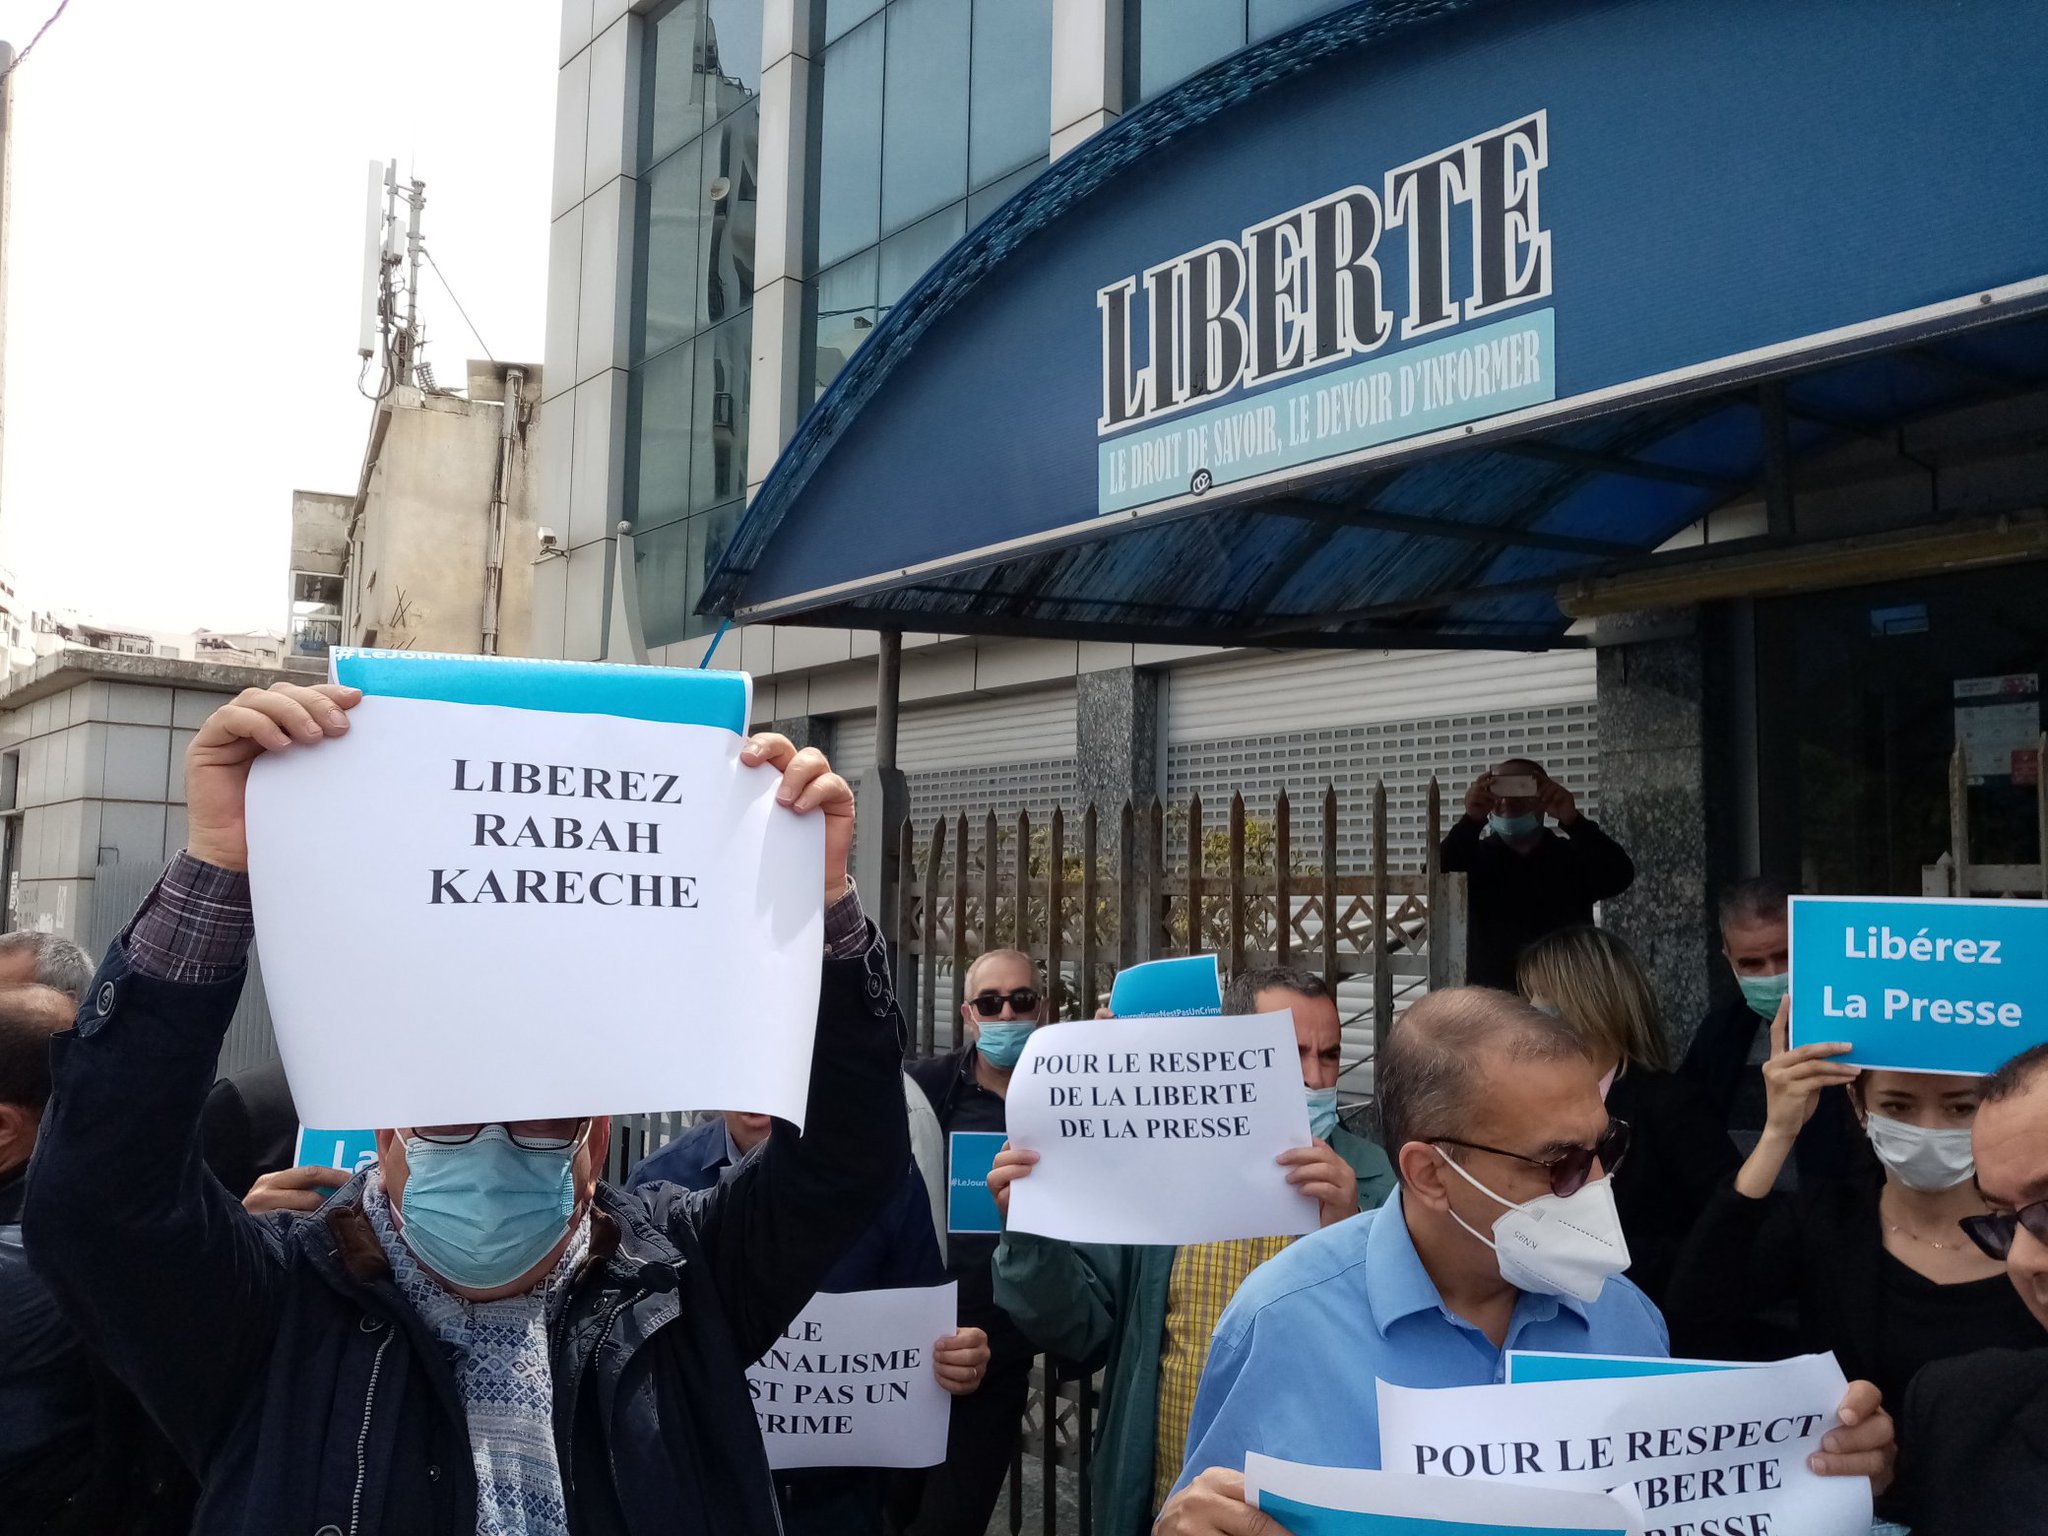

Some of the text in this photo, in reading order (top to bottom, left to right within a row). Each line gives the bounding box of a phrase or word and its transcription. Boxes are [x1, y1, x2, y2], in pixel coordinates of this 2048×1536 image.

[1098, 110, 1551, 436] LIBERTE
[1110, 329, 1541, 495] LE DROIT DE SAVOIR, LE DEVOIR D'INFORMER
[450, 759, 683, 804] LIBEREZ
[471, 813, 662, 854] RABAH
[427, 869, 700, 909] KARECHE
[1845, 926, 2001, 964] Libérez
[1823, 985, 2022, 1027] La Presse
[1032, 1047, 1276, 1074] POUR LE RESPECT
[1049, 1082, 1257, 1107] DE LA LIBERTE
[1059, 1116, 1250, 1138] DE LA PRESSE
[1513, 1230, 1539, 1250] KN95
[793, 1384, 854, 1404] PAS
[865, 1380, 910, 1404] UN
[1412, 1413, 1823, 1477] POUR LE RESPECT
